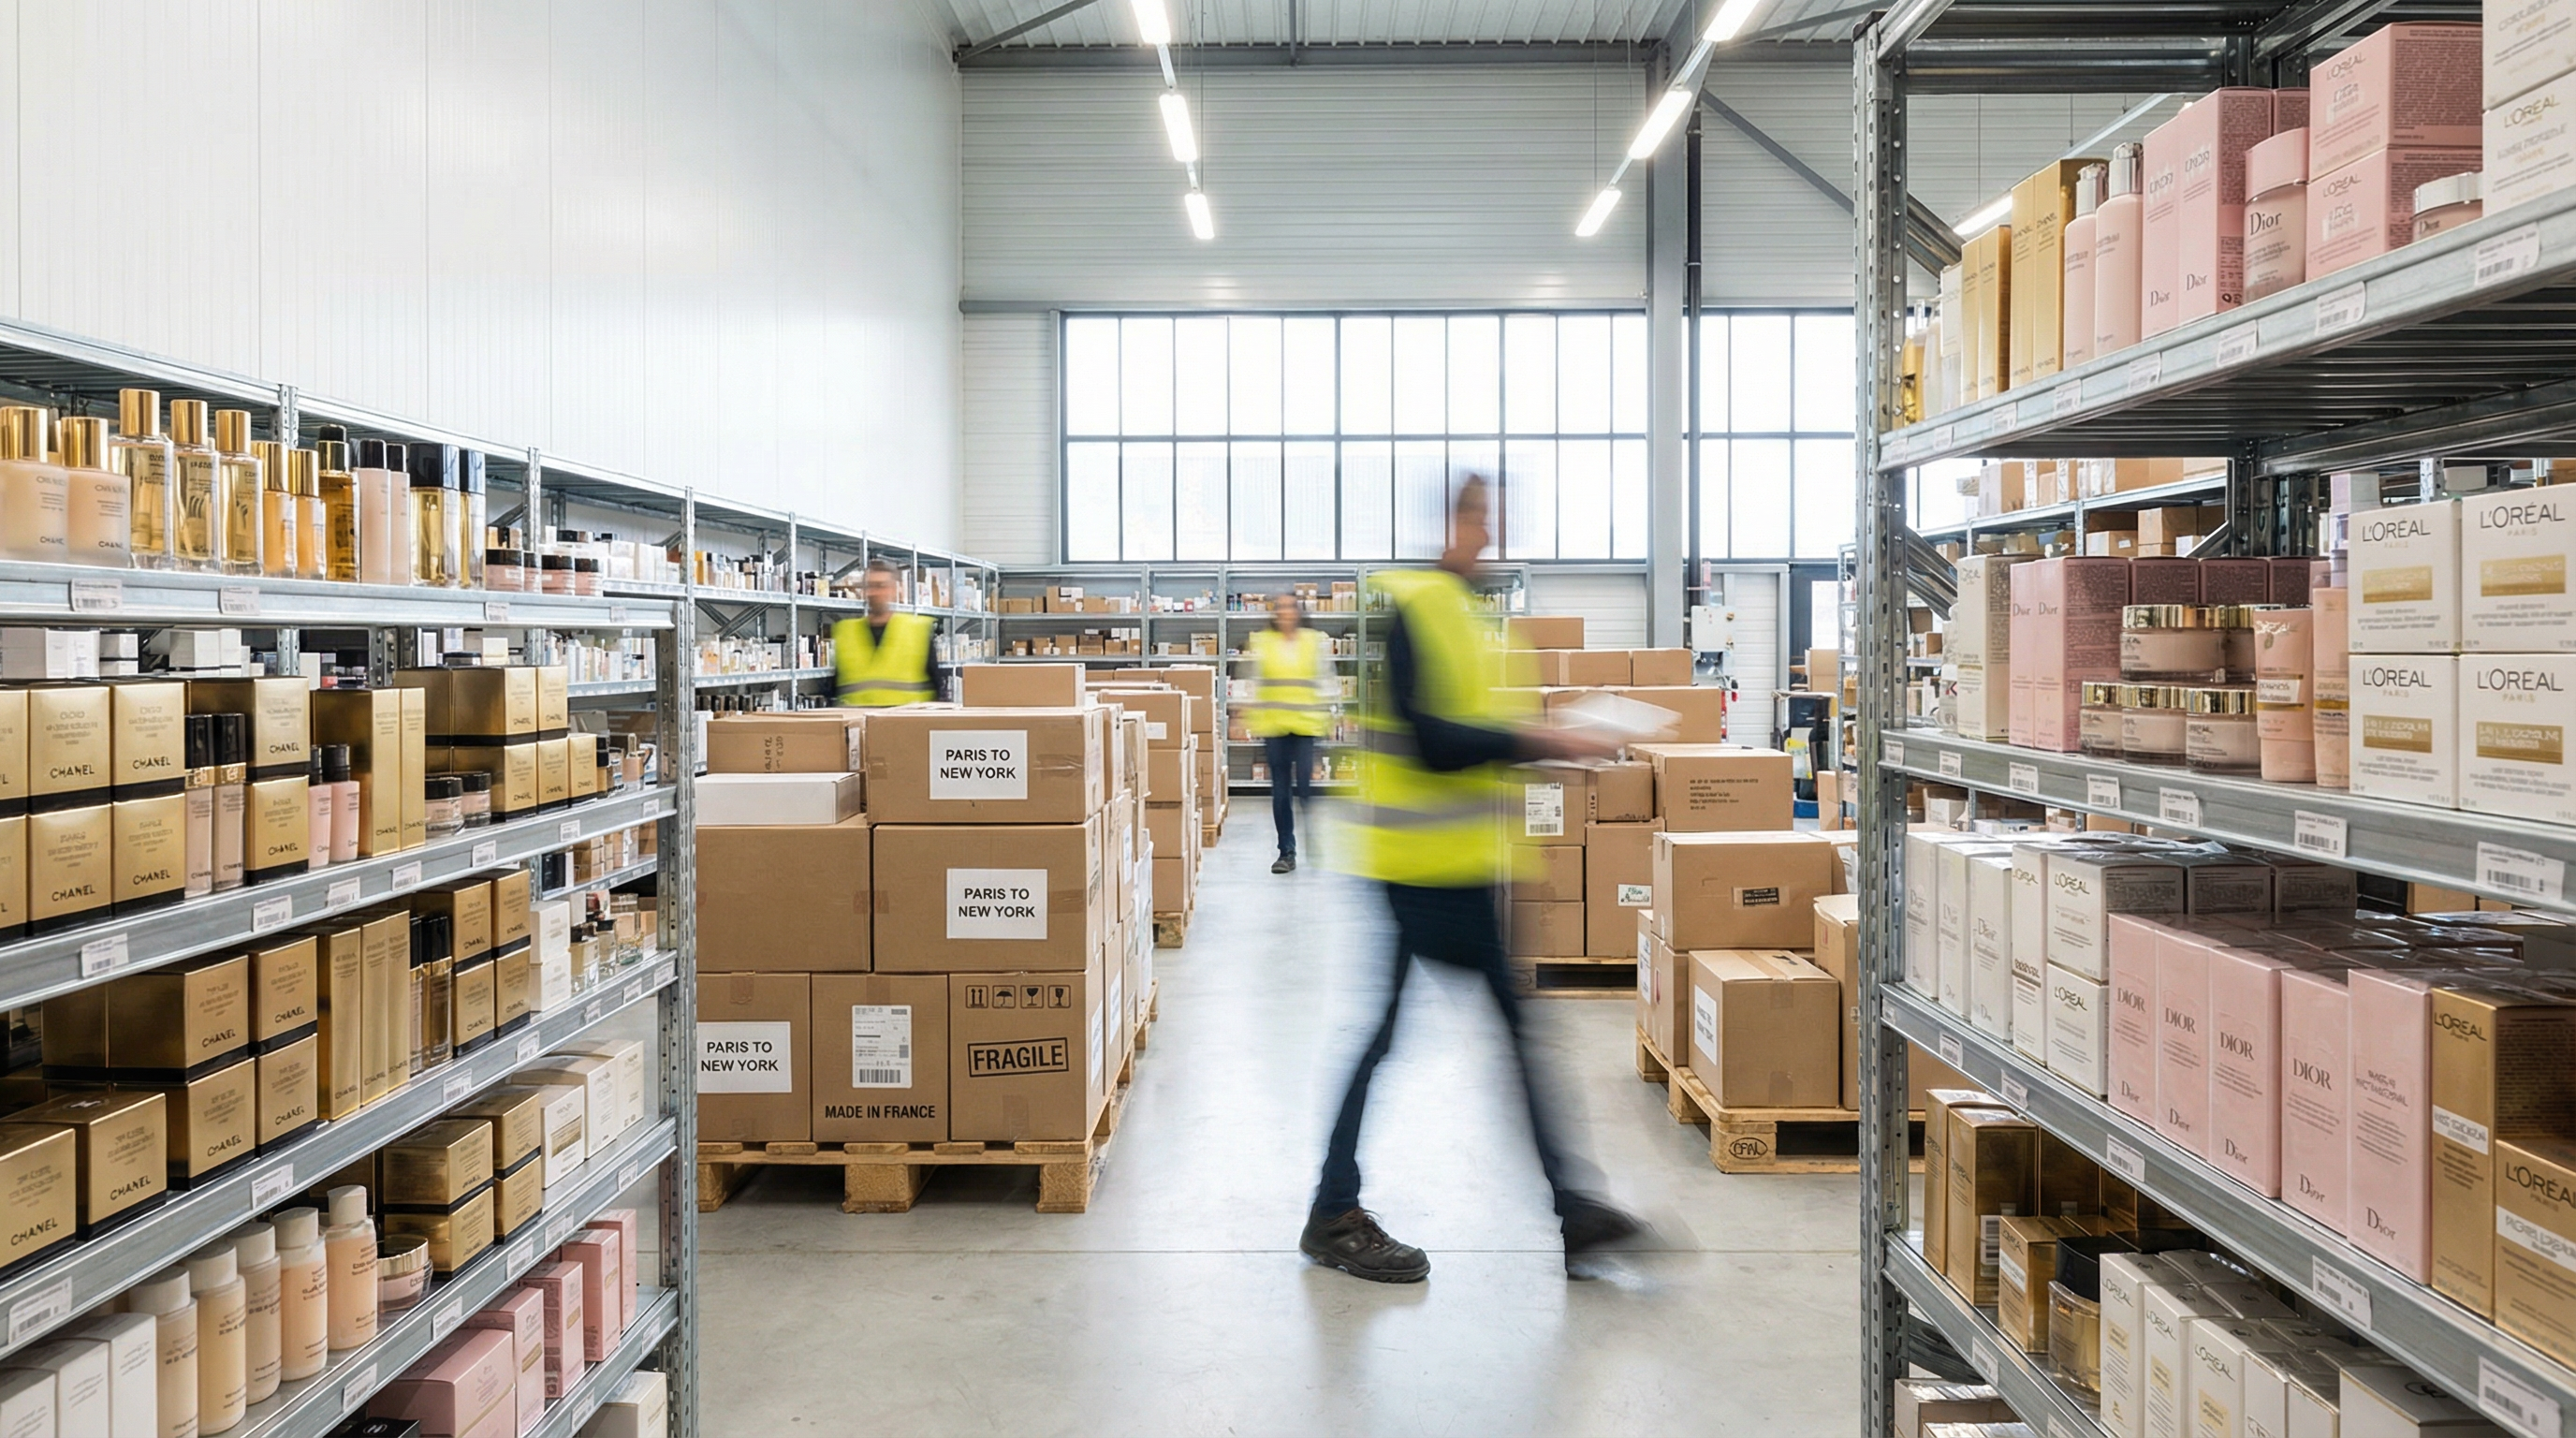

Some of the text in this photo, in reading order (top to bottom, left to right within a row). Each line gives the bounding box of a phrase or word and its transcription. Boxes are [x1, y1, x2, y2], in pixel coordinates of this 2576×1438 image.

[2250, 212, 2282, 236] Dior
[2481, 503, 2566, 529] L'ORÉAL
[2362, 518, 2431, 542] L'ORÉAL
[133, 756, 171, 770] CHANEL
[945, 749, 1011, 762] PARIS TO
[50, 764, 95, 779] CHANEL
[940, 768, 1017, 779] NEW YORK
[133, 869, 171, 886] CHANEL
[51, 884, 95, 902] CHANEL
[964, 888, 1030, 901] PARIS TO
[959, 905, 1035, 917] NEW YORK
[2117, 988, 2146, 1013] DIOR
[2165, 1007, 2196, 1034] DIOR
[201, 1028, 237, 1049] CHANEL
[707, 1041, 772, 1053] PARIS TO
[2220, 1032, 2255, 1061] DIOR
[700, 1060, 779, 1072] NEW YORK
[973, 1045, 1064, 1071] FRAGILE
[2293, 1058, 2333, 1091] DIOR
[825, 1106, 936, 1119] MADE IN FRANCE
[110, 1175, 152, 1200] CHANEL
[10, 1217, 59, 1246] CHANEL
